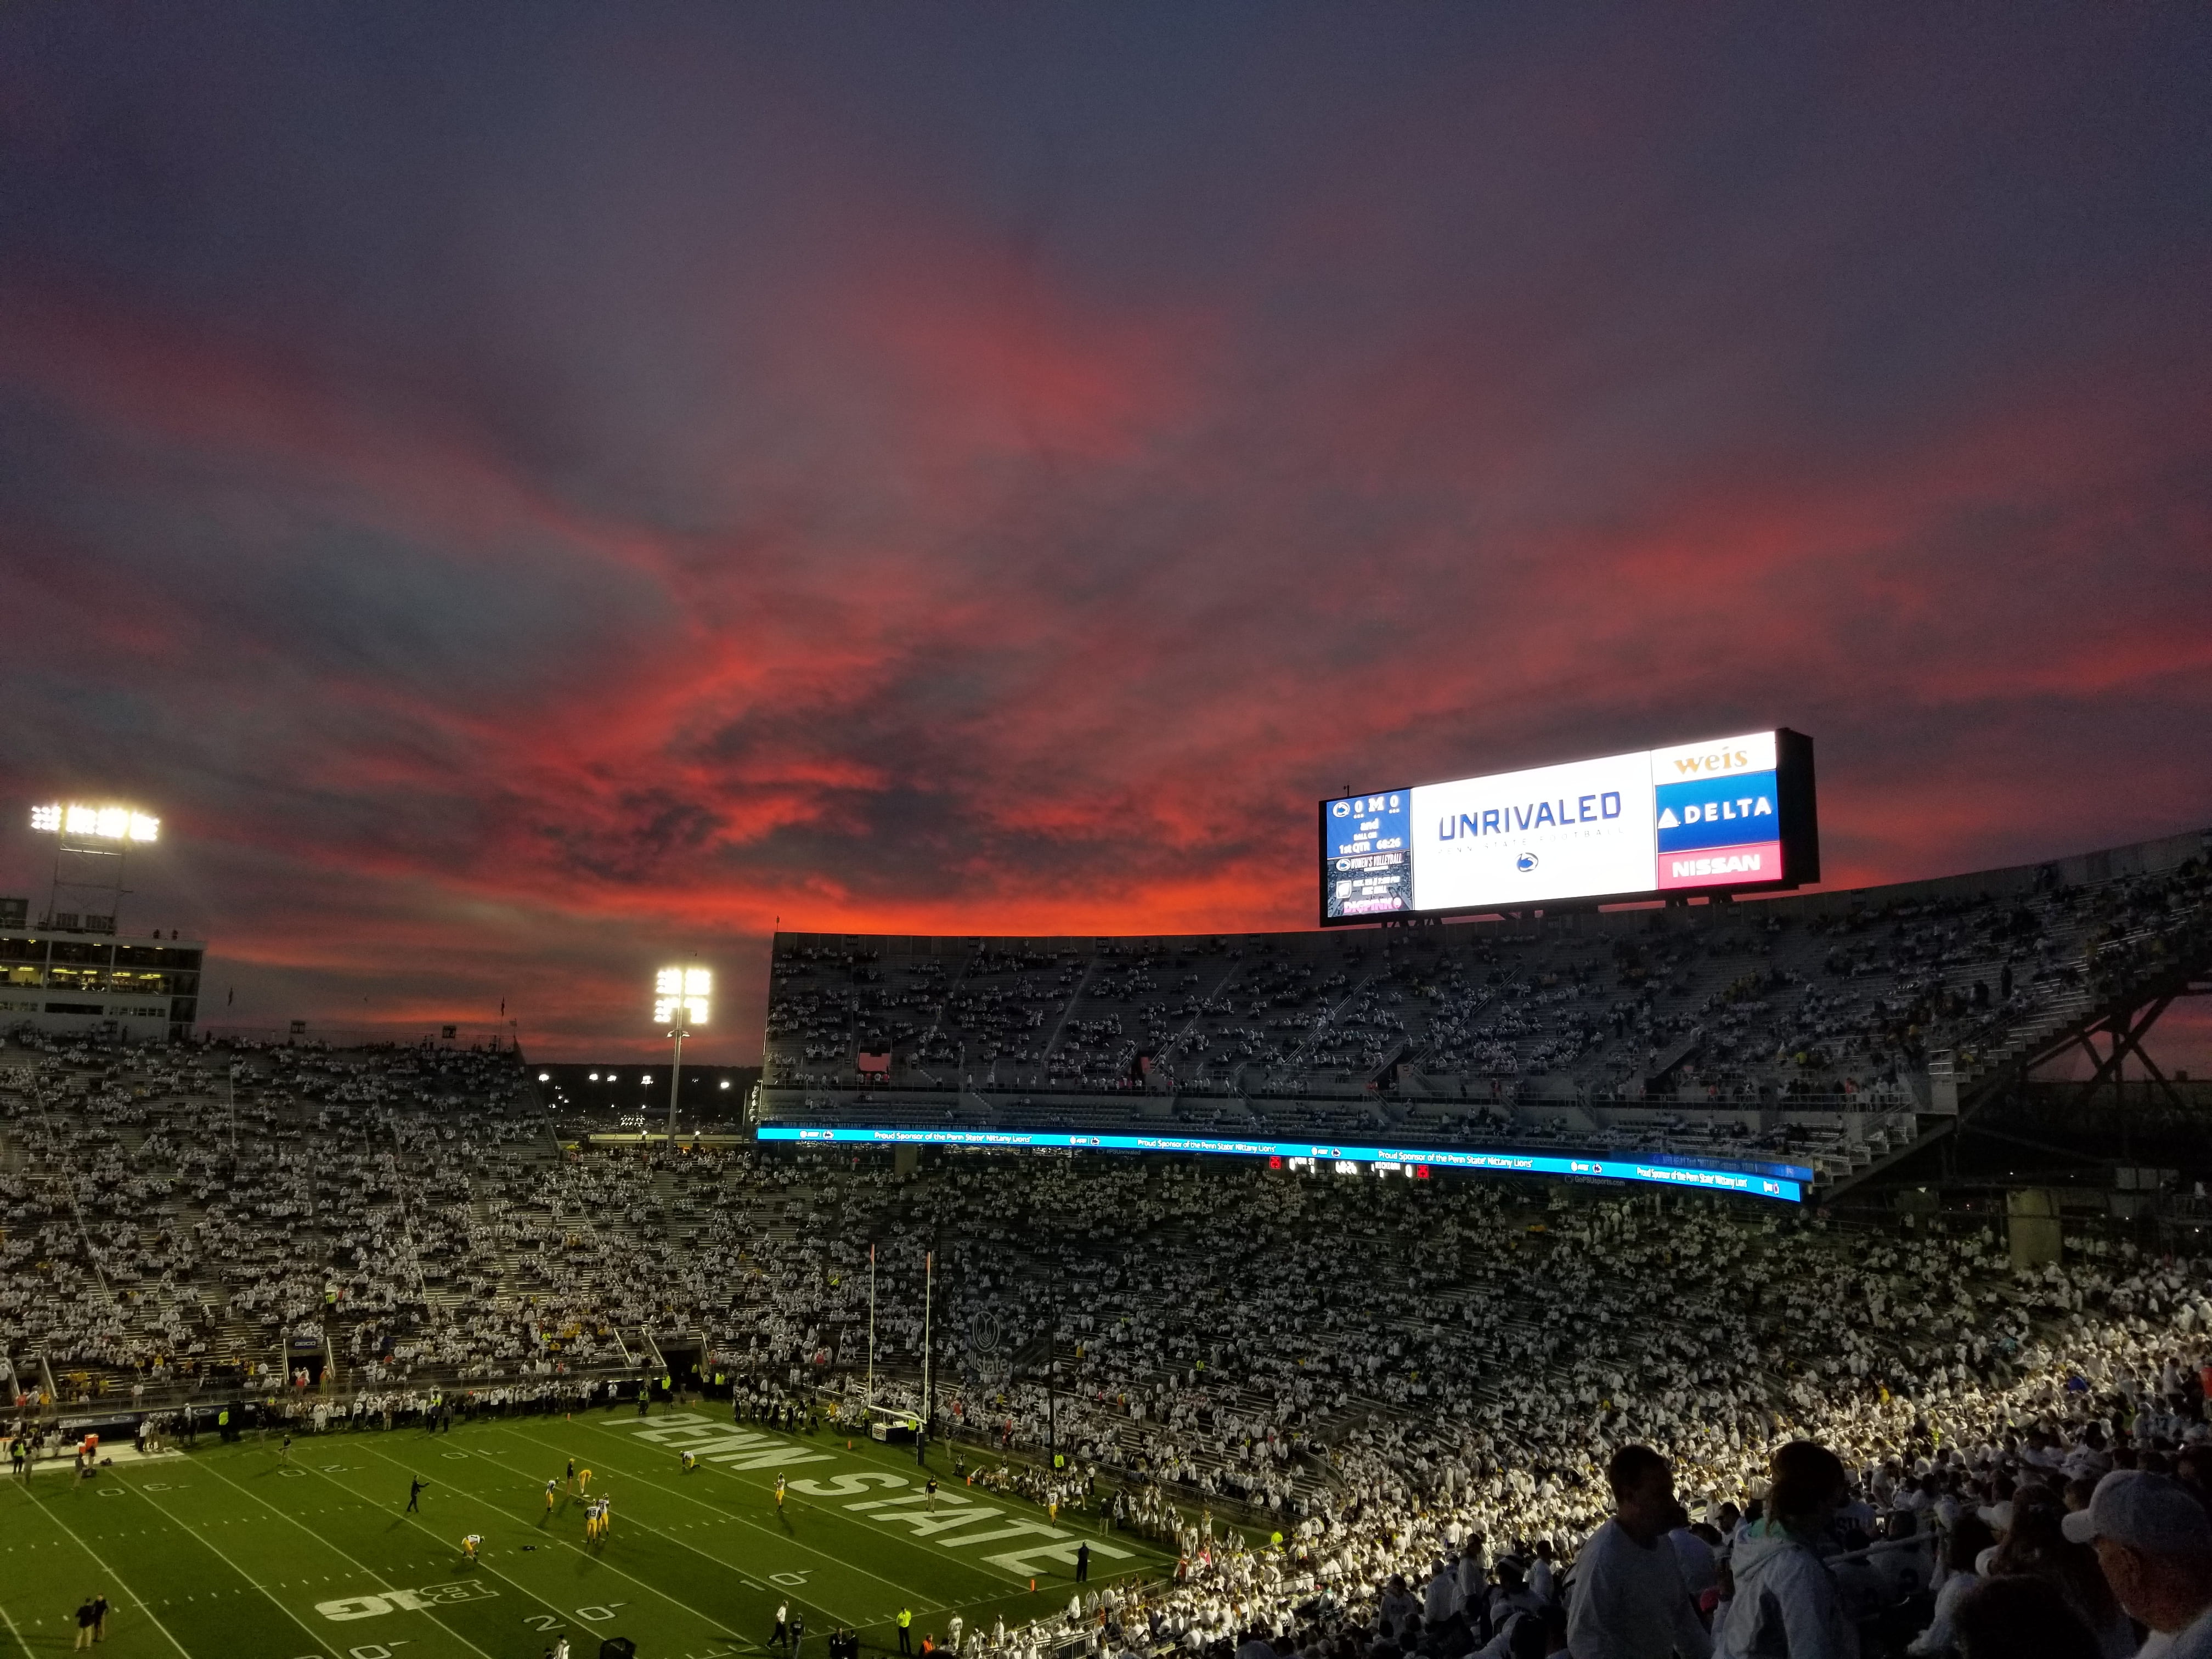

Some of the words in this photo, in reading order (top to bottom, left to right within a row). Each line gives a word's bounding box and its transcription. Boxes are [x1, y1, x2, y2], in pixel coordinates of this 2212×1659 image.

[1674, 746, 1748, 775] weis
[1355, 800, 1363, 813] 0
[1368, 797, 1384, 812] M
[1390, 795, 1398, 808] 0
[1684, 797, 1771, 824] DELTA
[1360, 817, 1379, 831] and
[1439, 791, 1621, 841] UNRIVALED
[1484, 838, 1527, 849] STATE
[1540, 827, 1624, 842] FOOTBALL
[1339, 844, 1352, 854] 1st
[1352, 841, 1370, 853] QTR
[1351, 856, 1373, 869] WOMEN'S
[1374, 853, 1402, 866] VOLLEYBALL
[1672, 854, 1760, 878] NISSAN
[874, 1131, 895, 1139] Proud
[896, 1132, 924, 1141] Sponsor
[986, 1135, 1011, 1143] Nittany
[1158, 1139, 1182, 1149] Sponsor
[1183, 1140, 1190, 1148] of
[1201, 1141, 1216, 1149] Penn
[1235, 1143, 1257, 1153] Nittany
[1375, 1161, 1400, 1170] MICHIGAN
[1378, 1150, 1397, 1159] Proud
[1398, 1152, 1426, 1162] Sponsor
[1436, 1154, 1447, 1162] the
[1448, 1154, 1465, 1164] Penn
[1488, 1157, 1513, 1169] Nittany
[1637, 1166, 1651, 1177] Proud
[1575, 1176, 1626, 1187] GoPSUsports.com
[965, 1348, 1008, 1374] Allstate
[599, 1413, 839, 1470] PENN
[787, 1471, 1136, 1577] STATE
